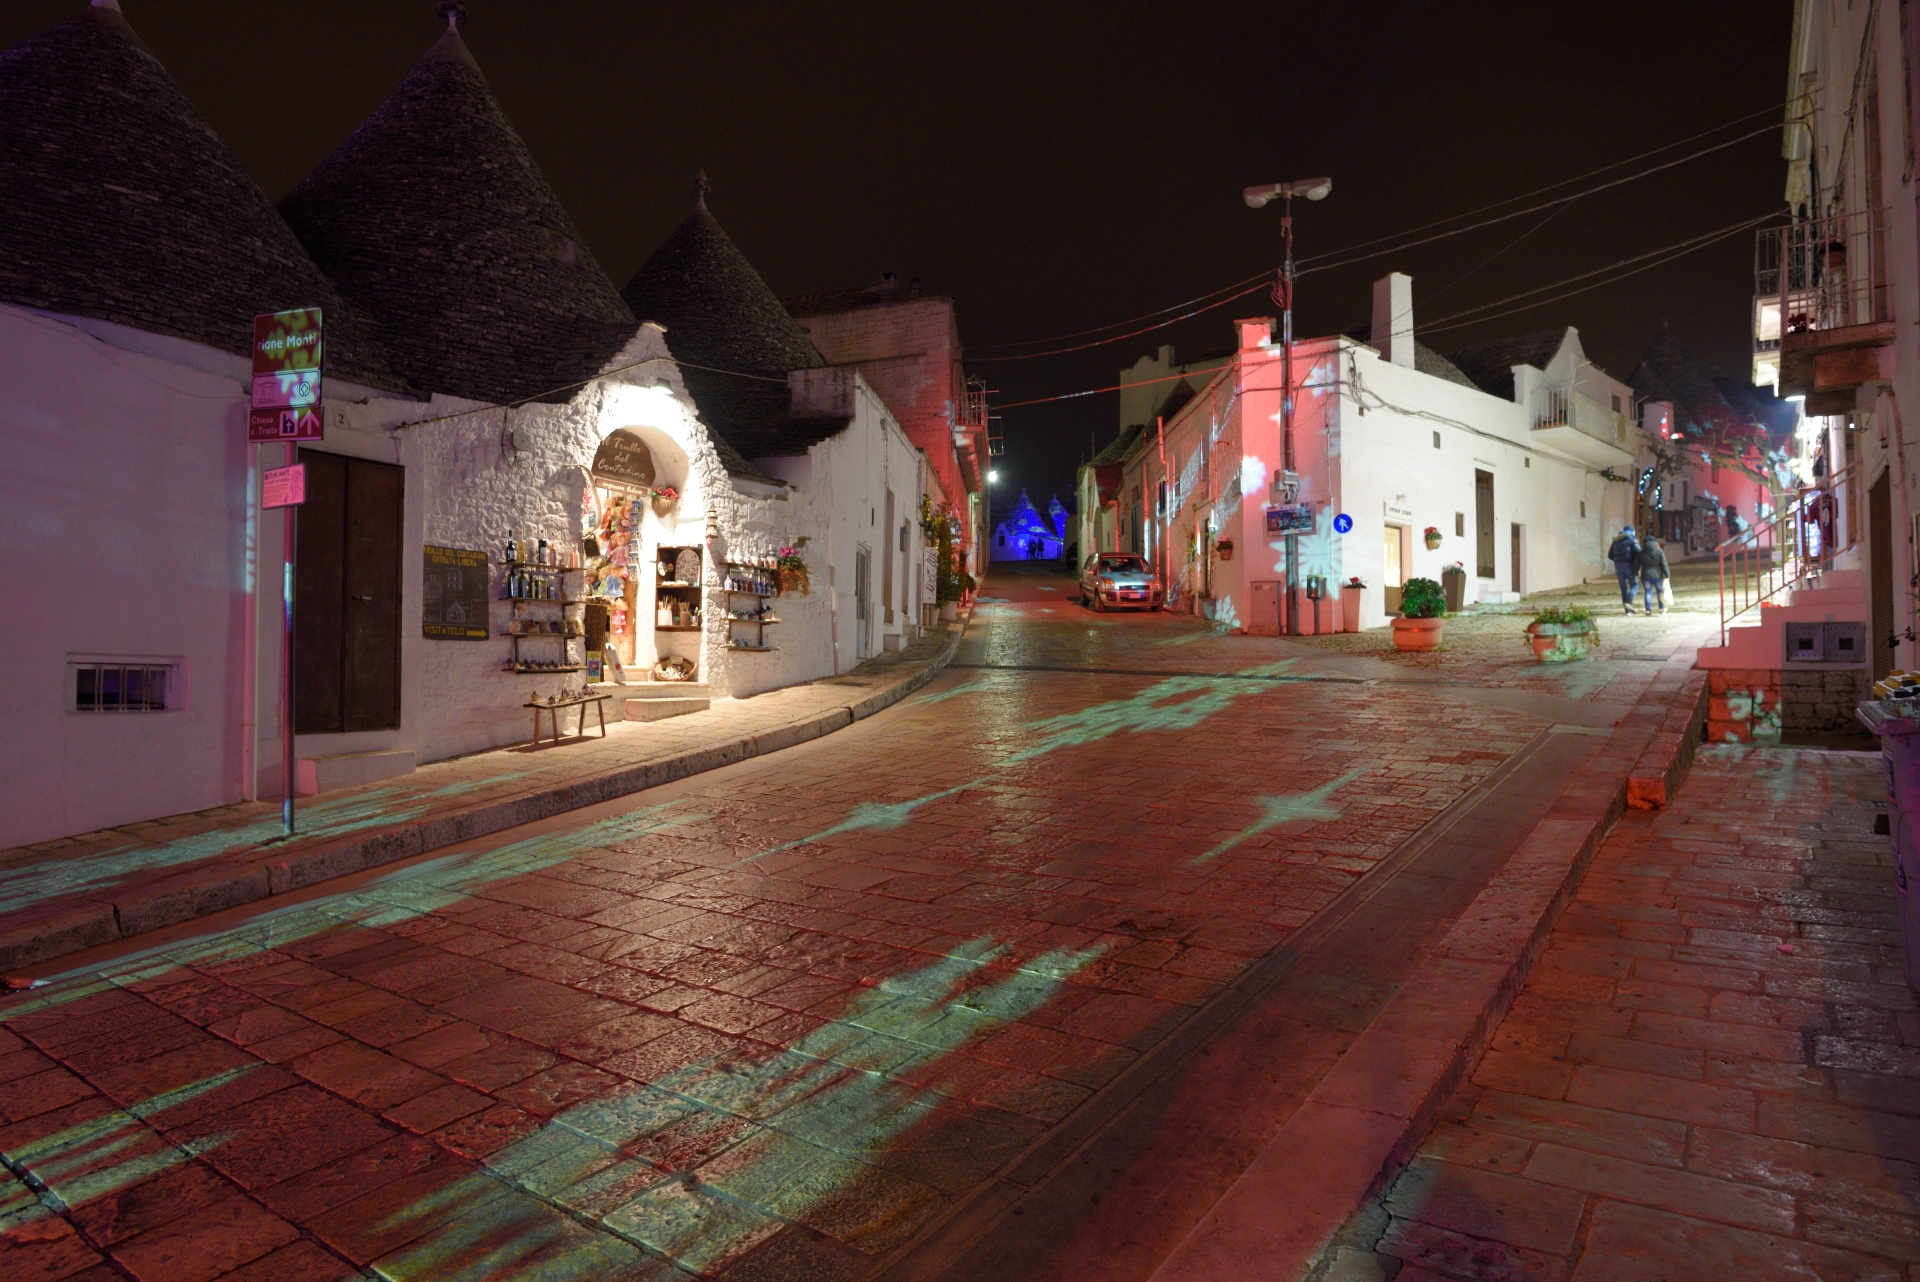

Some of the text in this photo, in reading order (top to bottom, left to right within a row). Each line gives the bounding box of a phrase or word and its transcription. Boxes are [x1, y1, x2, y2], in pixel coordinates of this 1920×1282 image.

[258, 333, 317, 350] rione Monti
[251, 416, 274, 424] Chiesa
[338, 412, 345, 424] 2
[257, 426, 278, 435] Trullo
[614, 437, 641, 454] Trullo
[614, 452, 630, 463] del
[597, 458, 646, 479] Contadino
[423, 546, 486, 560] TRULLO DEL CONTADINO
[432, 555, 477, 567] ENTRATA LIBERA
